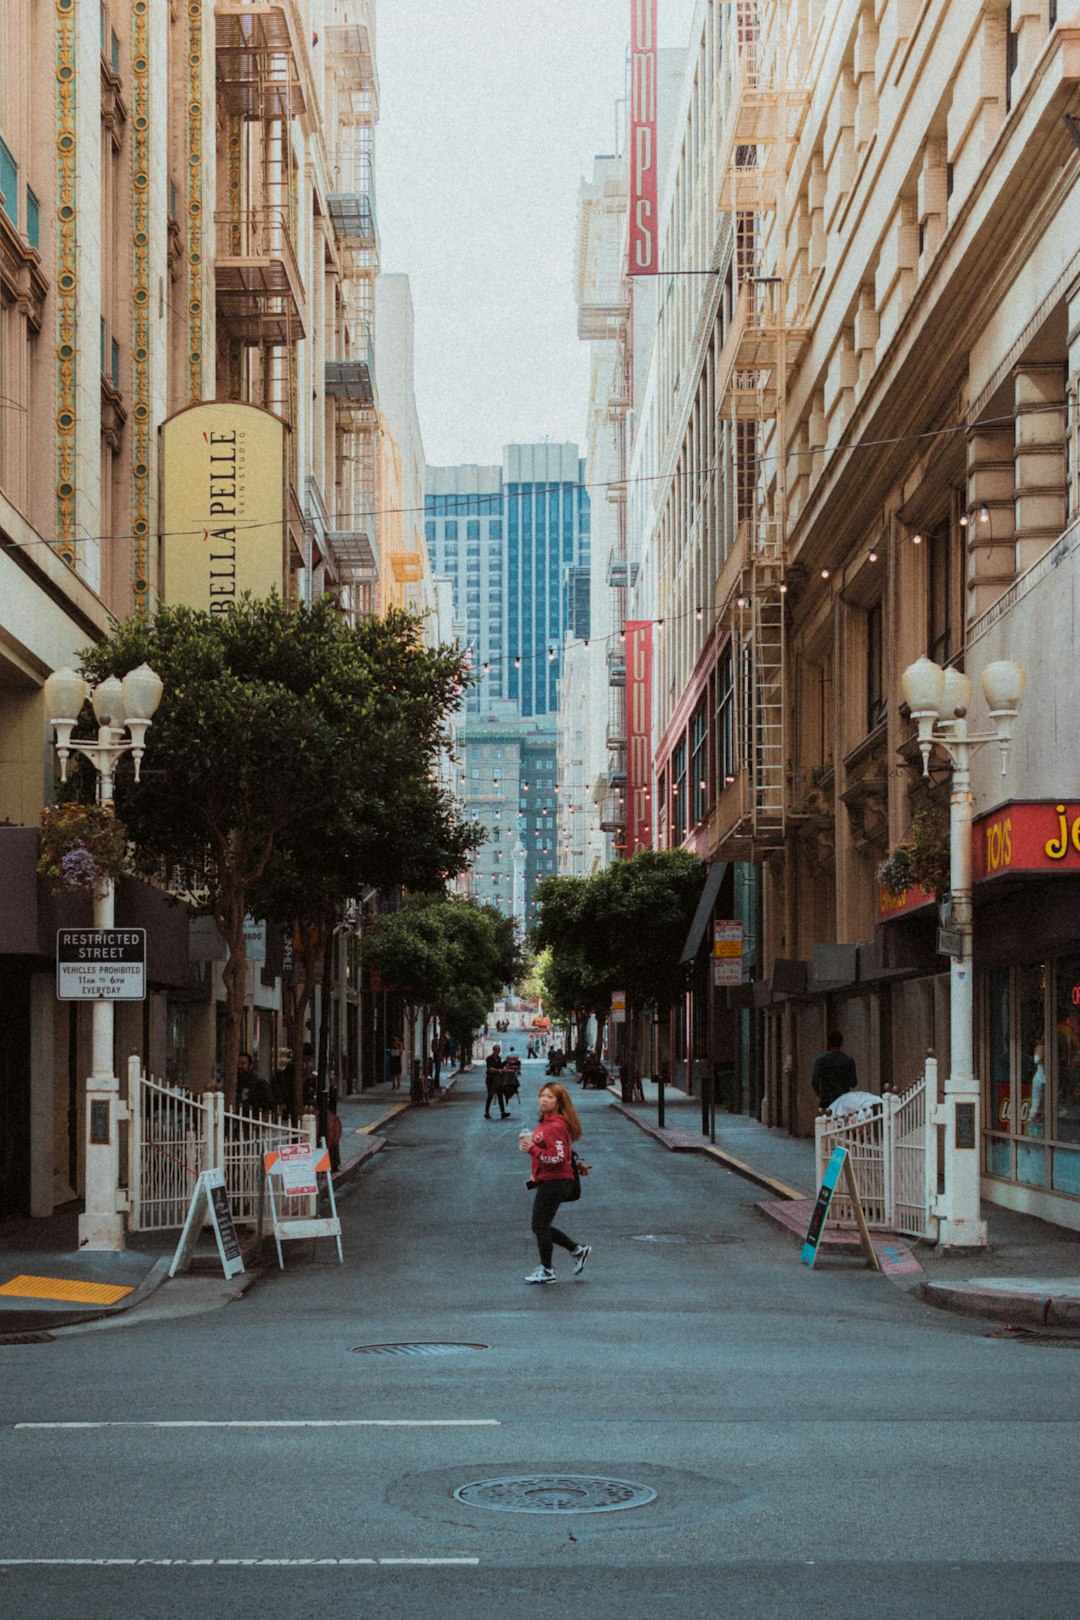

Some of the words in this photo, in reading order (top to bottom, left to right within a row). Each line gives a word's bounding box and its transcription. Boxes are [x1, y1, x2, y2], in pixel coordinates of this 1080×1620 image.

[238, 432, 246, 479] STUDIO
[238, 485, 246, 514] SKIN
[986, 818, 1012, 873] TOYS
[63, 934, 140, 945] RESTRICTED
[78, 947, 125, 959] STREET
[62, 966, 96, 974] VEHICLES
[99, 966, 141, 974] PROHIBITED
[109, 976, 125, 984] 6PM
[82, 986, 121, 994] EVERYDAY
